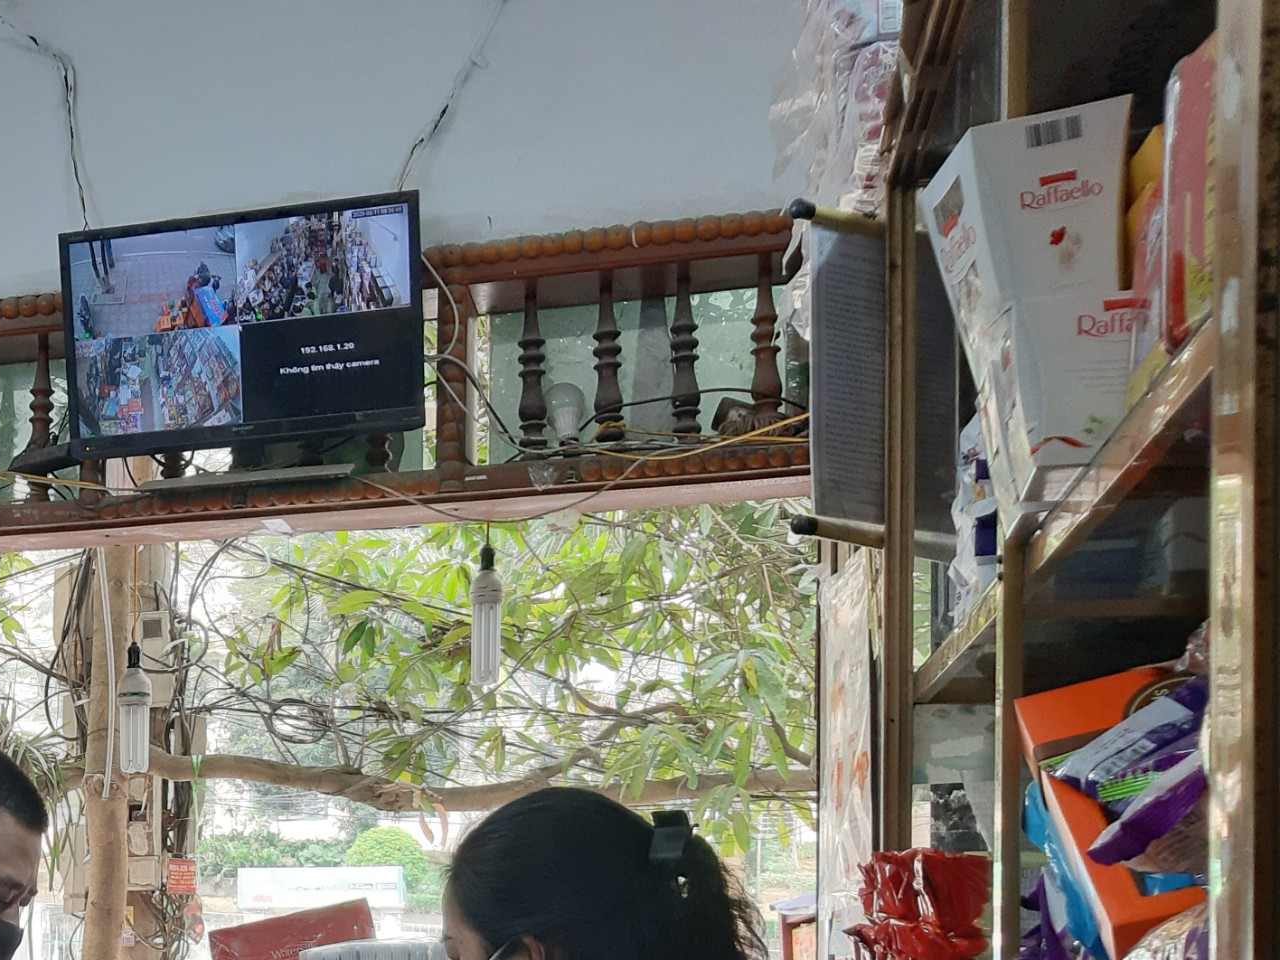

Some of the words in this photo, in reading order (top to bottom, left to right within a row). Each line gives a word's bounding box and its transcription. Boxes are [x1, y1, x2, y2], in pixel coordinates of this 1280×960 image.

[1020, 180, 1103, 210] Raffaello
[300, 342, 355, 354] 192.168.1.20
[279, 366, 310, 375] Không
[346, 358, 380, 368] camera
